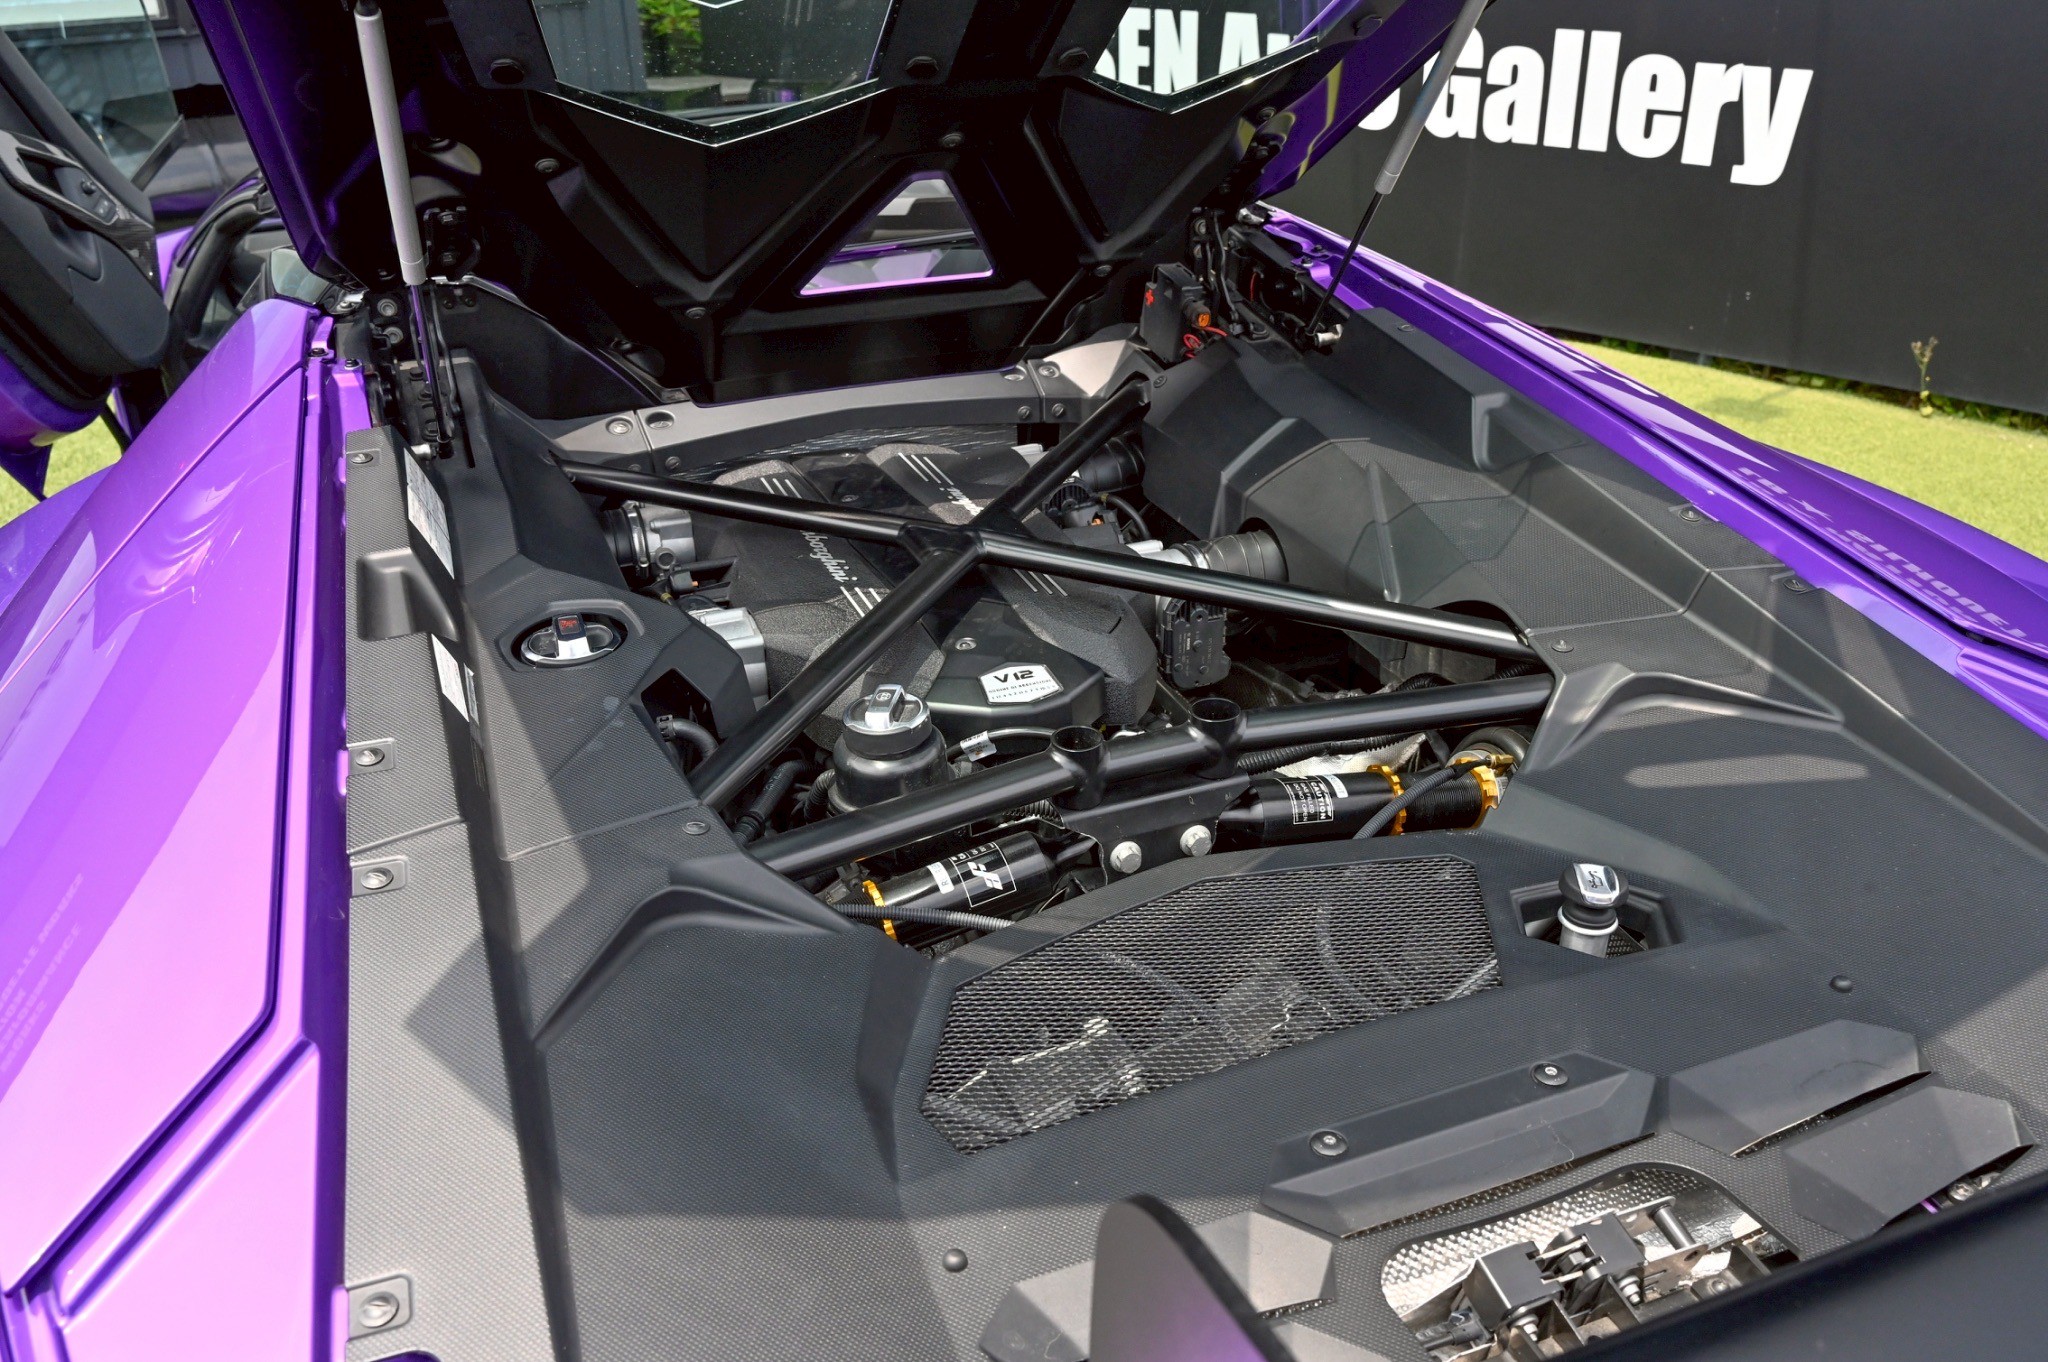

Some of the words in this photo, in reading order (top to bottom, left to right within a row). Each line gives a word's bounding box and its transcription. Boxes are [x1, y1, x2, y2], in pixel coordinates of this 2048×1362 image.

[1093, 7, 1199, 94] EN
[1422, 26, 1814, 186] Gallery
[993, 669, 1035, 683] V12
[1297, 790, 1306, 803] NOT
[1311, 782, 1326, 819] CAUTION
